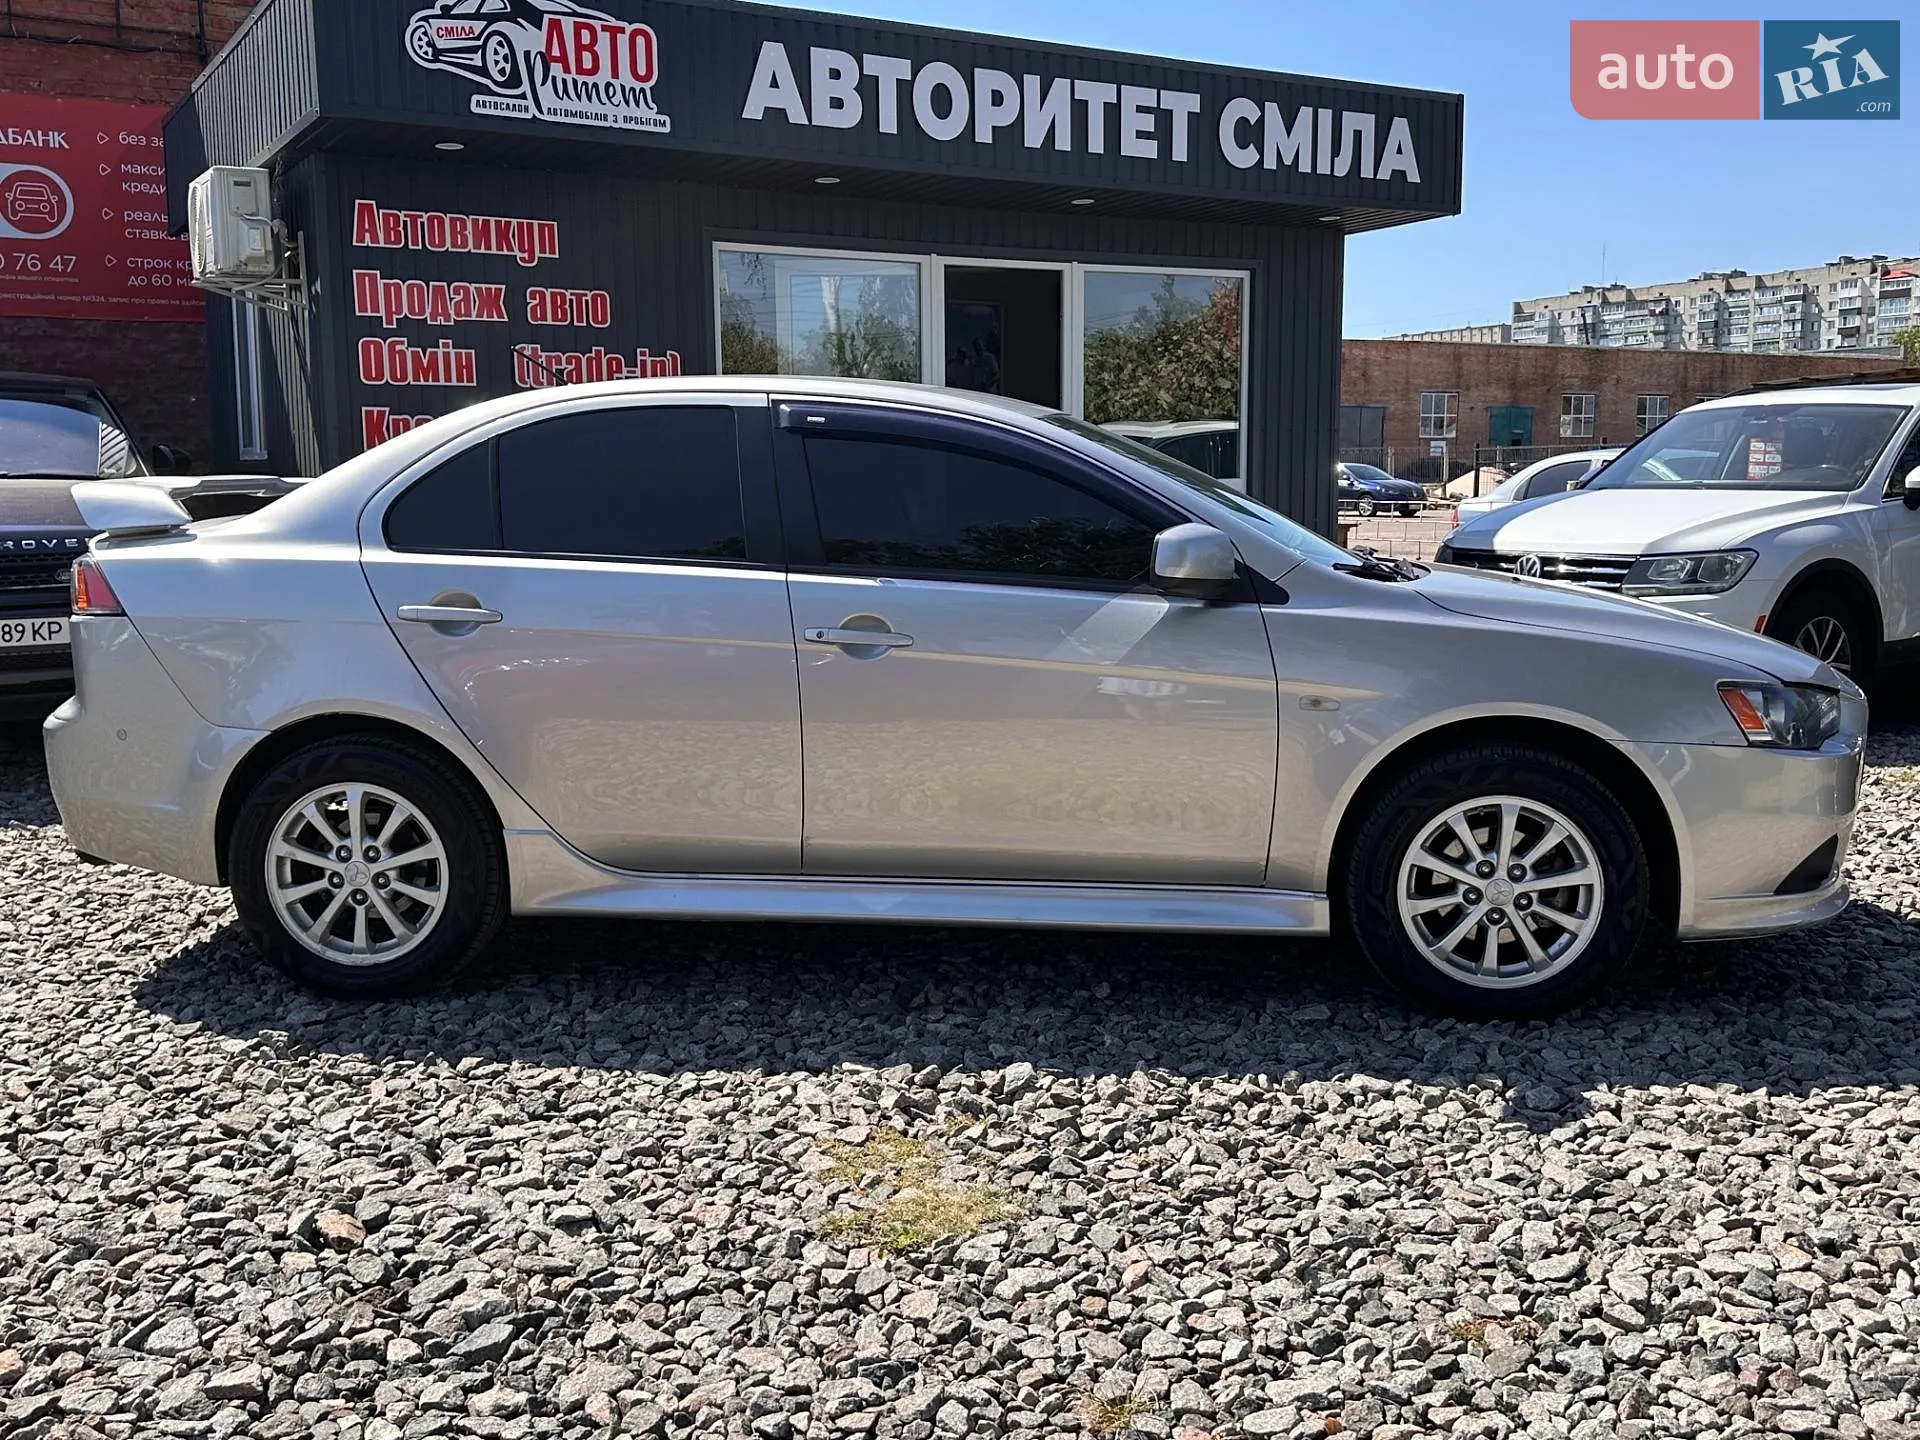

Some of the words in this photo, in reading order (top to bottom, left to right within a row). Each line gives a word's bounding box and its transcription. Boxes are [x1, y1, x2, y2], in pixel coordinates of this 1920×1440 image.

[435, 26, 476, 39] СМІЛА
[544, 17, 654, 84] АВТО
[475, 99, 530, 113] АВТОСАЛОН
[742, 41, 1200, 162] АВТОРИТЕТ
[1219, 97, 1421, 183] СМІЛА
[546, 107, 609, 122] АВТОМОБІЛІВ
[623, 115, 667, 128] ПРОБІГОМ
[119, 131, 146, 146] без
[353, 199, 559, 267] Автовикуп
[12, 253, 41, 271] 76
[49, 255, 76, 272] 47
[127, 257, 172, 270] строк
[127, 275, 147, 286] до
[151, 274, 172, 286] 60
[353, 269, 508, 328] Продаж
[527, 286, 611, 328] авто
[358, 337, 476, 386] Обмін
[1, 623, 25, 642] 89
